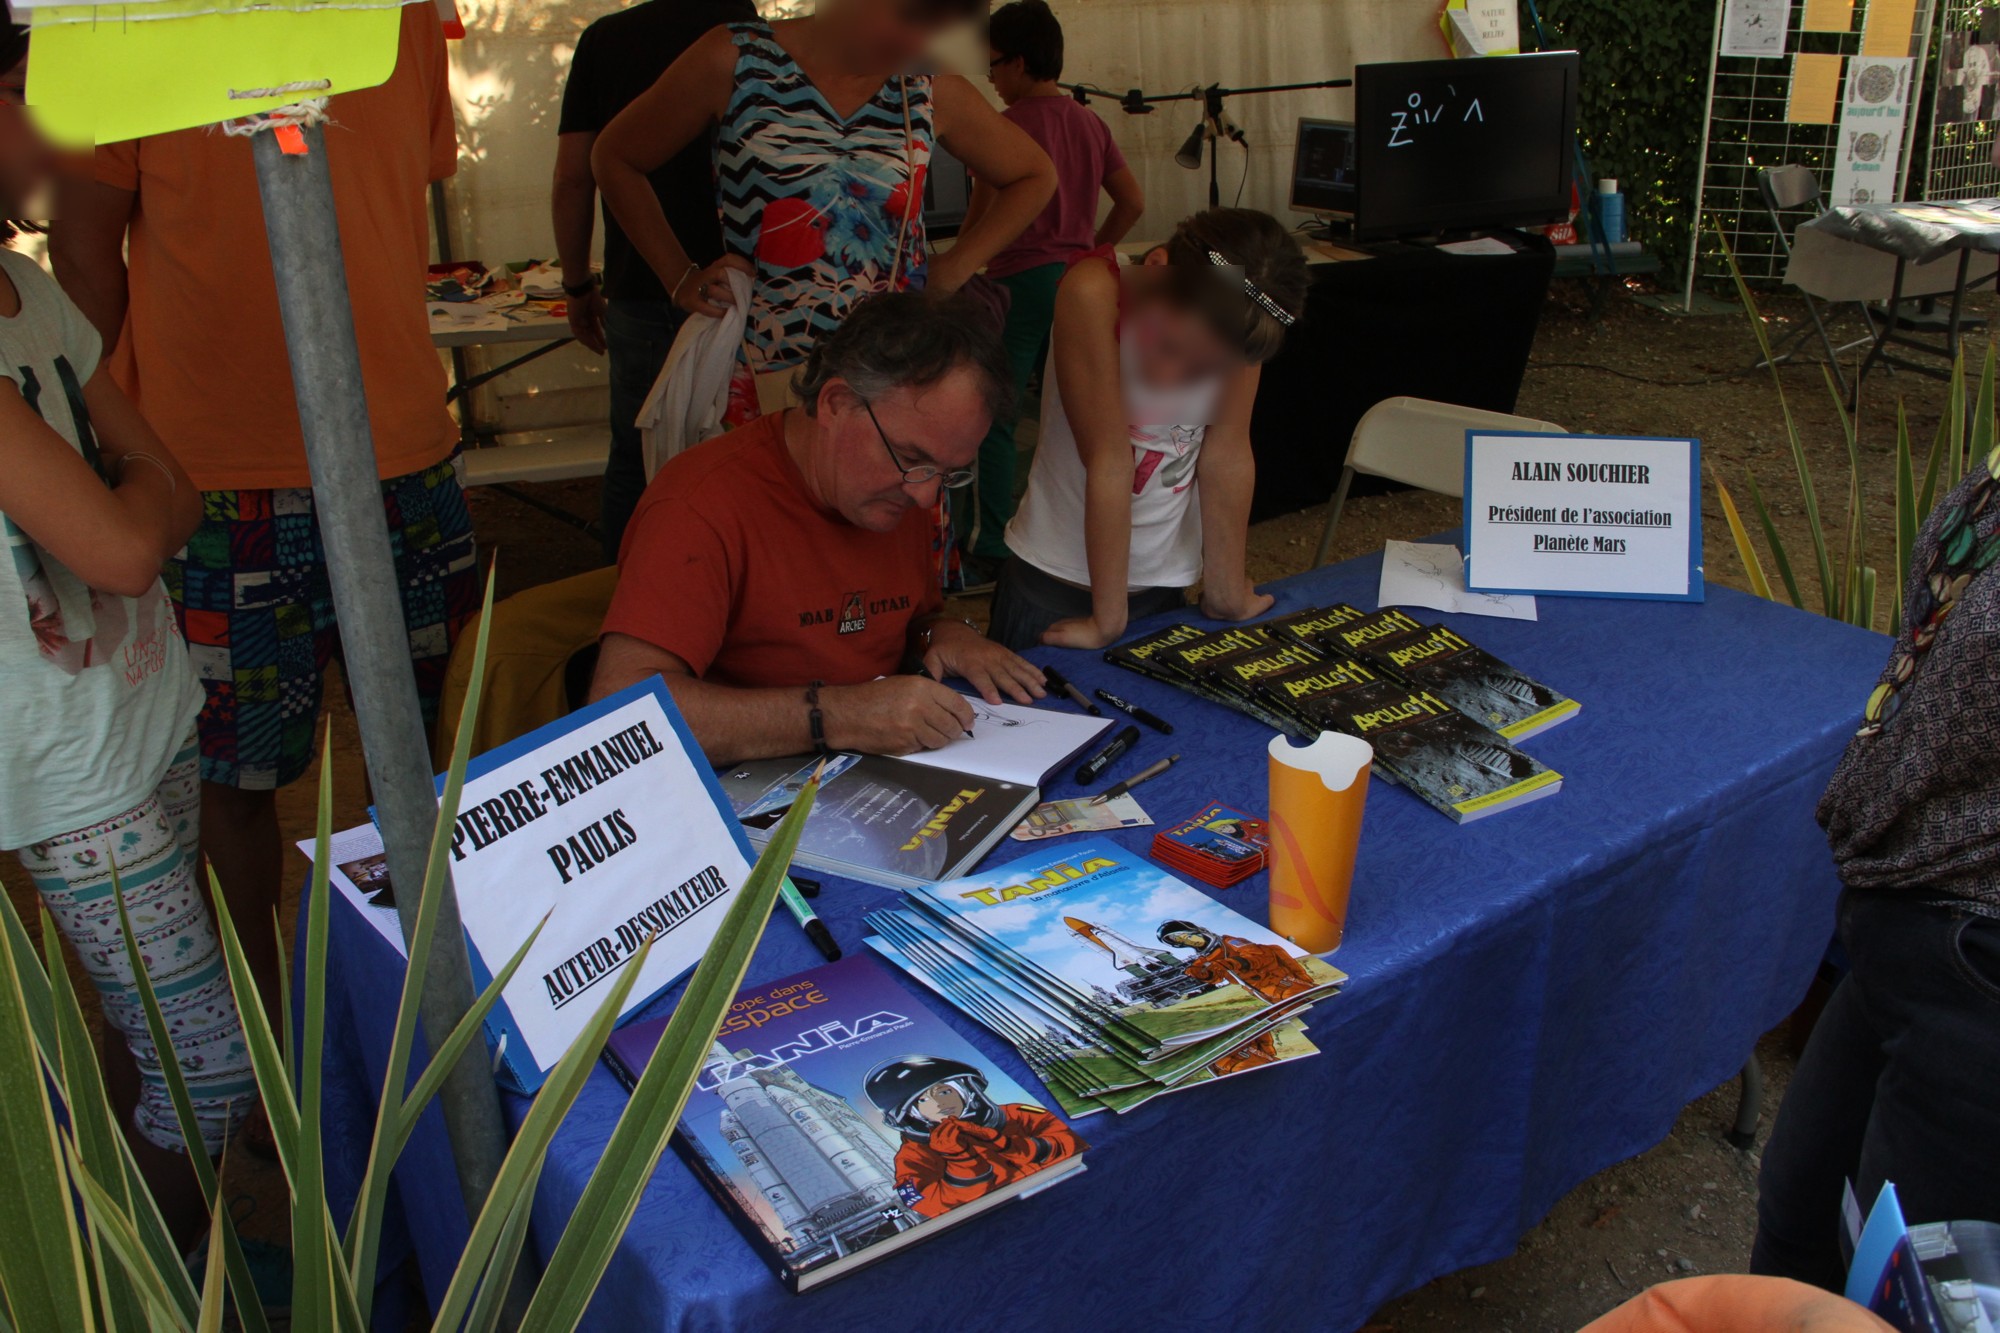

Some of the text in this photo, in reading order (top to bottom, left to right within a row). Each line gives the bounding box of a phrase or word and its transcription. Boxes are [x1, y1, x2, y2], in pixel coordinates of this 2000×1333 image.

[1512, 462, 1650, 484] ALAIN SOUCHIER
[1488, 505, 1672, 527] Président de l'association
[1533, 534, 1626, 554] Planète Mars
[869, 595, 911, 616] UTAH
[840, 618, 866, 633] ARCHES
[449, 720, 664, 862] PIERRE-EMMANUEL
[546, 808, 637, 884] PAULIS
[542, 865, 728, 1006] AUTEUR-DESSINATEUR
[770, 979, 815, 999] dans
[838, 1020, 914, 1050] Pierre-Emmanuel Paulis
